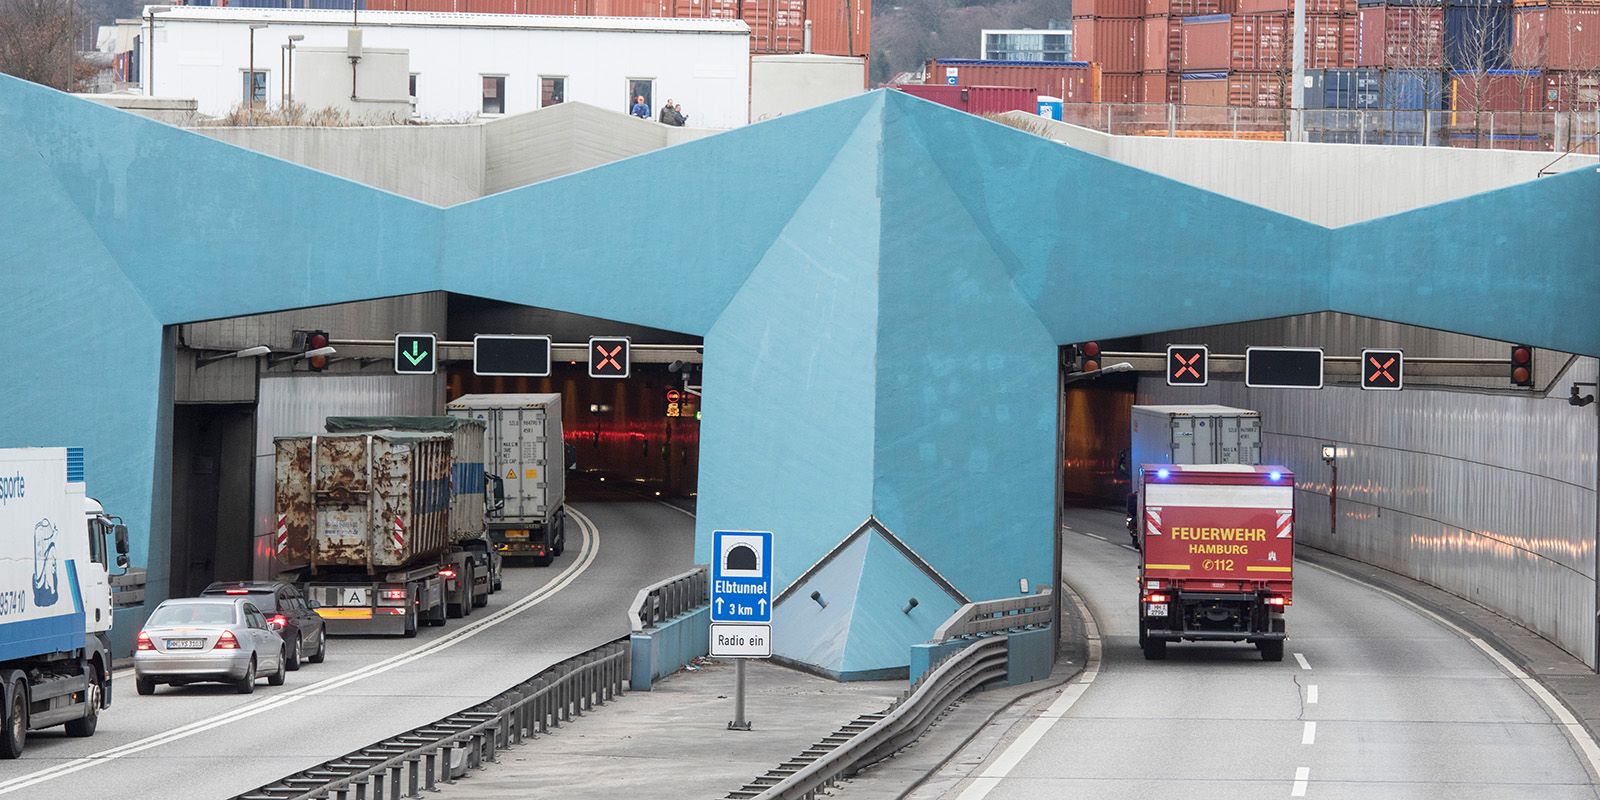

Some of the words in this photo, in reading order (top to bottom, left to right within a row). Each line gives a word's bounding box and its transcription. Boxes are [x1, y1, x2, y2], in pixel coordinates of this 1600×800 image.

[1171, 527, 1266, 541] FEUERWEHR
[1189, 544, 1248, 554] HAMBURG
[1214, 560, 1234, 570] 112
[715, 580, 767, 594] Elbtunnel
[349, 592, 360, 603] A
[729, 604, 735, 615] 3
[738, 604, 752, 615] km
[718, 635, 744, 646] Radio
[749, 635, 764, 646] ein
